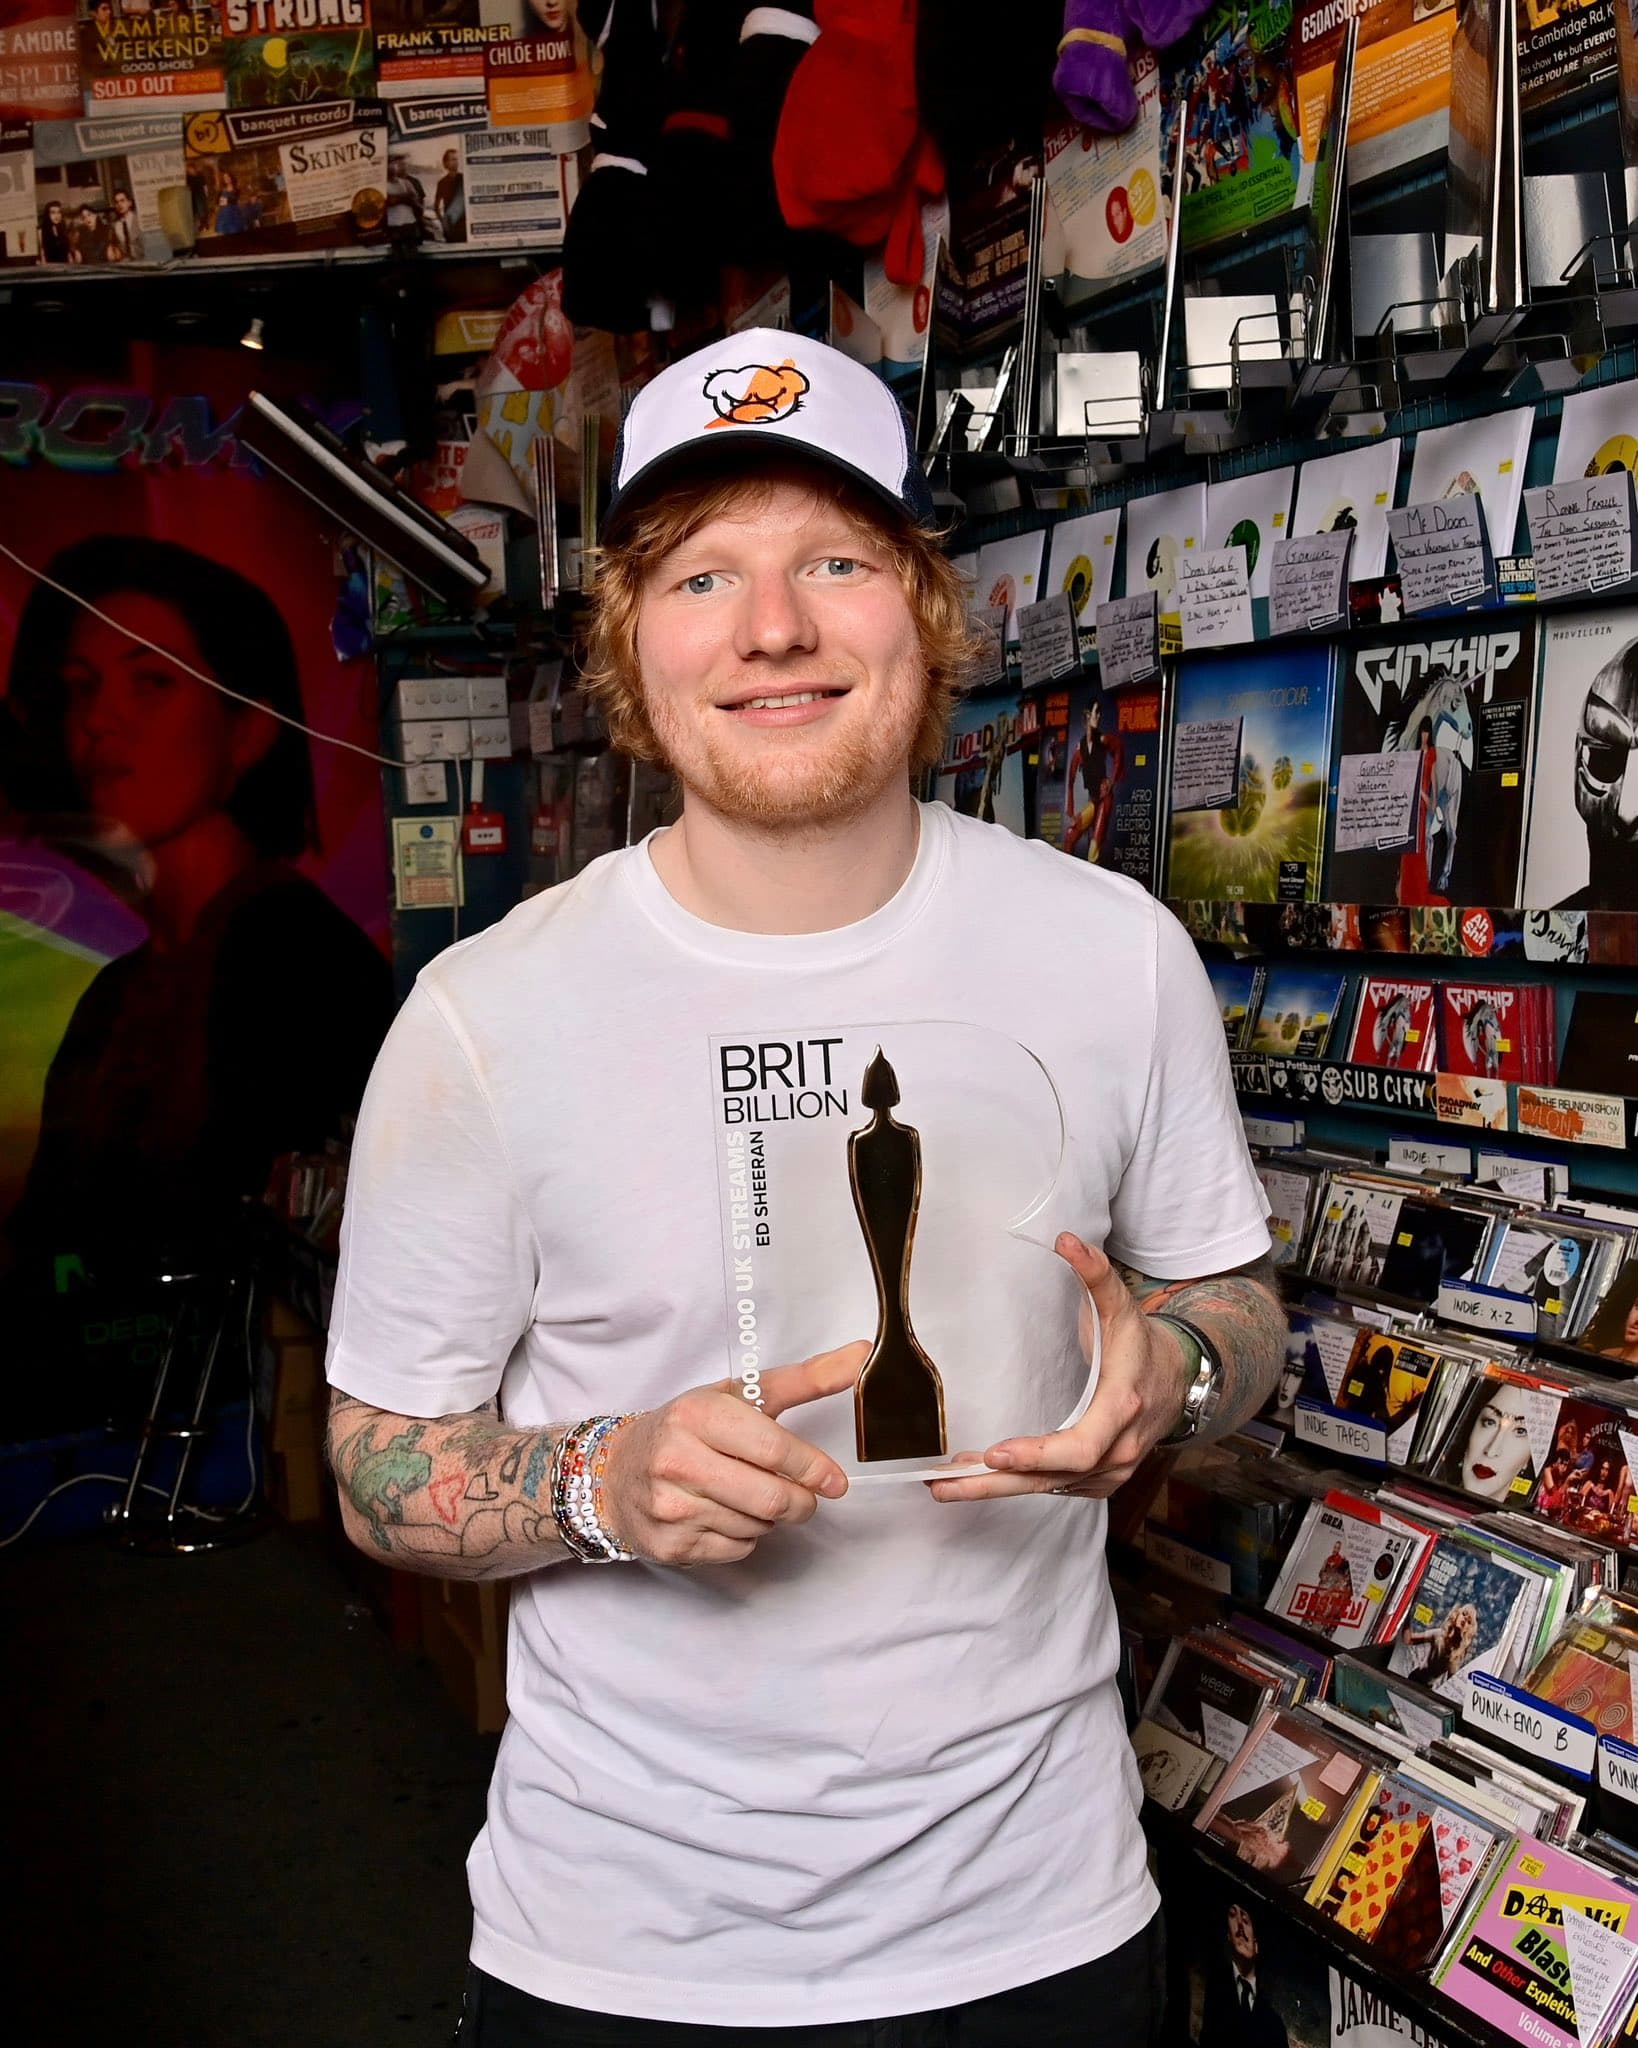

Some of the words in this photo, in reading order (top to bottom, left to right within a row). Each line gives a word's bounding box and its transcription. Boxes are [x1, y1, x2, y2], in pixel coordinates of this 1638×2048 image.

[95, 13, 207, 38] VAMPIRE
[377, 32, 433, 51] FRANK
[440, 25, 512, 43] TURNER
[1531, 17, 1588, 50] Cambridge
[97, 37, 210, 62] WEEKEND
[489, 43, 532, 66] CHLÖE
[1533, 57, 1552, 71] show
[1553, 50, 1568, 63] 16+
[1569, 43, 1583, 56] but
[121, 61, 156, 74] GOOD
[158, 59, 195, 72] SHOES
[1528, 76, 1545, 90] AGE
[1545, 68, 1562, 81] YOU
[1563, 59, 1579, 74] ARE
[1582, 48, 1612, 67] Respect
[94, 79, 138, 99] SOLD
[142, 75, 177, 95] OUT
[241, 116, 297, 133] banquet
[300, 105, 347, 125] records
[409, 101, 466, 122] banquet
[289, 130, 376, 174] SKINTS
[1499, 560, 1516, 571] THE
[1355, 630, 1521, 717] GUNSHIP
[1131, 789, 1153, 802] AFRO
[1116, 803, 1152, 817] FUTURIST
[1116, 818, 1151, 832] ELECTRO
[1130, 834, 1150, 846] FUNK
[1125, 846, 1150, 861] SPACE
[1472, 912, 1489, 931] Ah
[1368, 981, 1433, 1013] GUNSHIP
[1446, 987, 1515, 1021] GUNSHIP
[720, 1038, 843, 1092] BRIT
[1269, 1057, 1285, 1069] Dan
[1343, 1068, 1379, 1100] SUB
[1383, 1074, 1427, 1108] CITY
[724, 1089, 848, 1124] BILLION
[1438, 1095, 1482, 1112] BROADWAY
[1438, 1104, 1464, 1117] CALLS
[1542, 1097, 1557, 1109] THE
[1558, 1099, 1594, 1113] REUNION
[1594, 1102, 1621, 1116] SHOW
[1402, 1149, 1431, 1165] INDIE:
[1436, 1154, 1446, 1168] T
[749, 1130, 769, 1217] SHEERAN
[726, 1130, 751, 1252] STREAMS
[755, 1225, 771, 1248] ED
[735, 1255, 755, 1291] UK
[1453, 1299, 1483, 1317] INDIE:
[1490, 1307, 1514, 1325] X-Z
[1303, 1414, 1329, 1437] INDIE
[1335, 1423, 1370, 1453] TAPES
[1385, 1539, 1401, 1553] 2.0
[1200, 1671, 1237, 1698] weezer
[1472, 1690, 1543, 1740] PUNK+EMO
[1554, 1727, 1569, 1751] B
[1516, 1928, 1571, 1988] Blast
[1466, 1944, 1493, 1968] And
[1491, 1959, 1526, 1989] Other
[1525, 1980, 1578, 2026] Expletive
[1336, 1970, 1404, 2036] JAMIE
[1517, 2011, 1562, 2048] Volume
